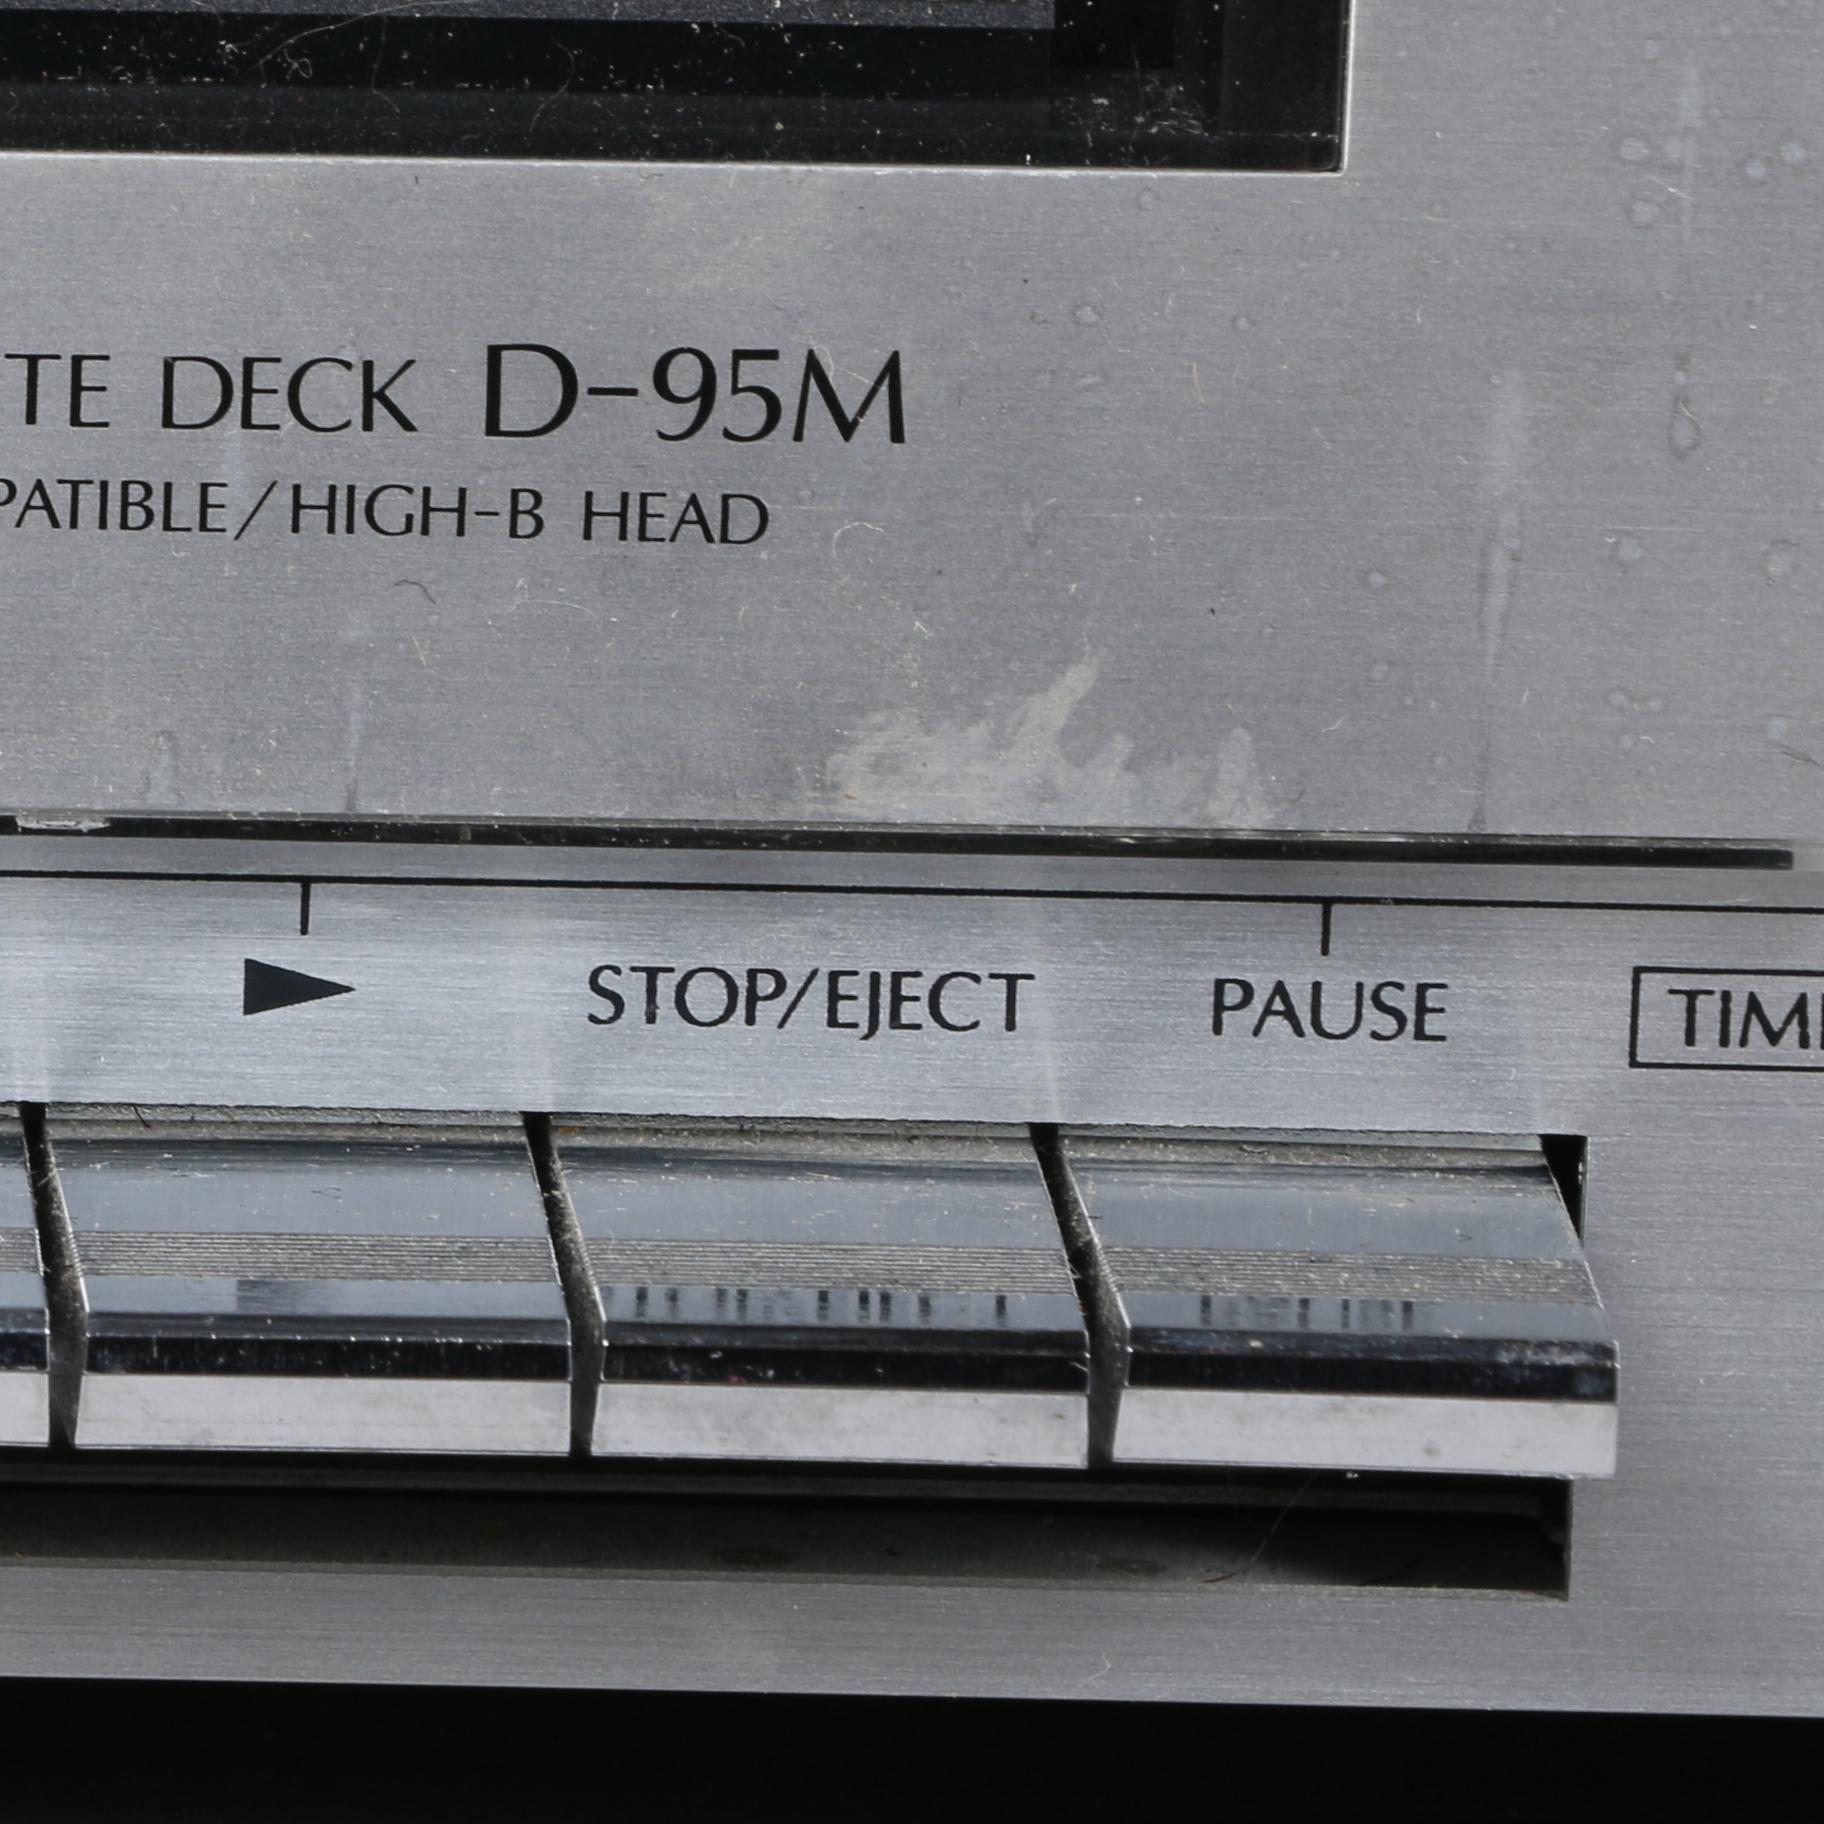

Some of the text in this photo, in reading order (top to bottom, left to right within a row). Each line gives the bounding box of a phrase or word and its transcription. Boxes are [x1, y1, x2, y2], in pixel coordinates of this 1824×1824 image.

[160, 354, 420, 434] DECK
[483, 342, 907, 446] D-95M
[581, 489, 771, 546] HEAD
[586, 963, 1037, 1042] STOP/EJECT
[1210, 976, 1450, 1043] PAUSE
[1666, 987, 1824, 1052] TIM
